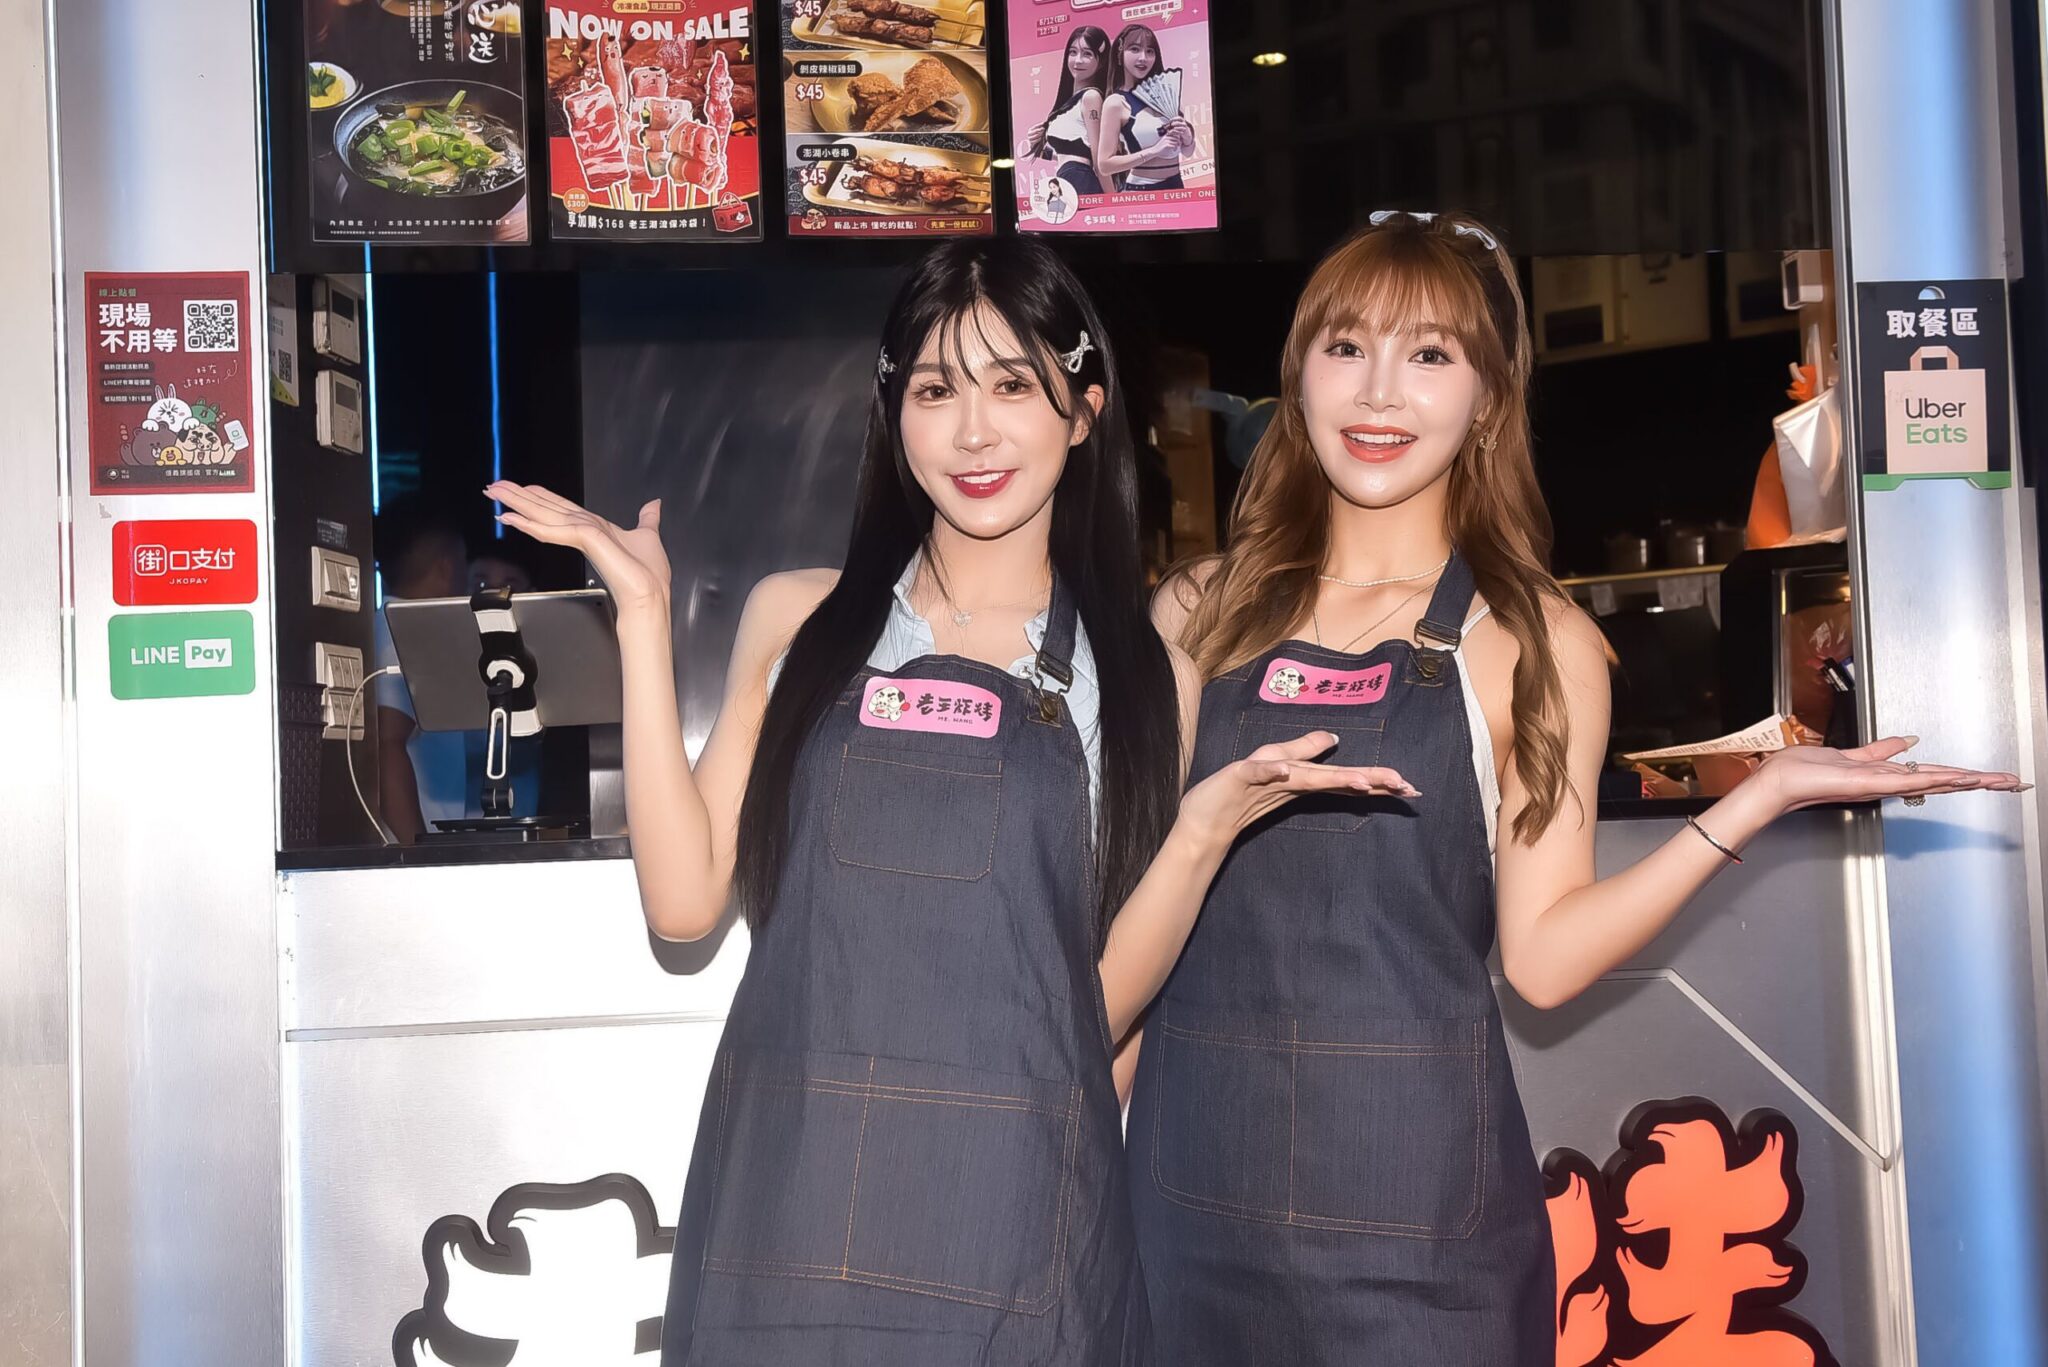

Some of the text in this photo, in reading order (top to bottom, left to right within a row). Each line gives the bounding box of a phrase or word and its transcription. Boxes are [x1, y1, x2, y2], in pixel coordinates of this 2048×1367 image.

[795, 0, 822, 16] $45
[549, 7, 750, 41] NOW ON SALE
[800, 64, 856, 74] 剝皮辣椒雞翅
[796, 83, 824, 100] $45
[802, 147, 850, 158] 澎湖小卷串
[800, 168, 827, 185] $45
[1111, 194, 1157, 203] MANAGER
[1163, 191, 1193, 200] EVENT
[1198, 190, 1216, 198] ONE
[834, 221, 867, 229] 新品上市
[98, 302, 151, 328] 現場
[1886, 307, 1980, 338] 取餐區
[100, 328, 178, 353] 不用等
[1905, 398, 1967, 418] Uber
[1906, 423, 1968, 444] Eats
[137, 548, 236, 571] 街口支付
[169, 577, 209, 585] JKOPAY
[131, 645, 226, 665] LINE Pay
[916, 693, 993, 722] 老王炸烤
